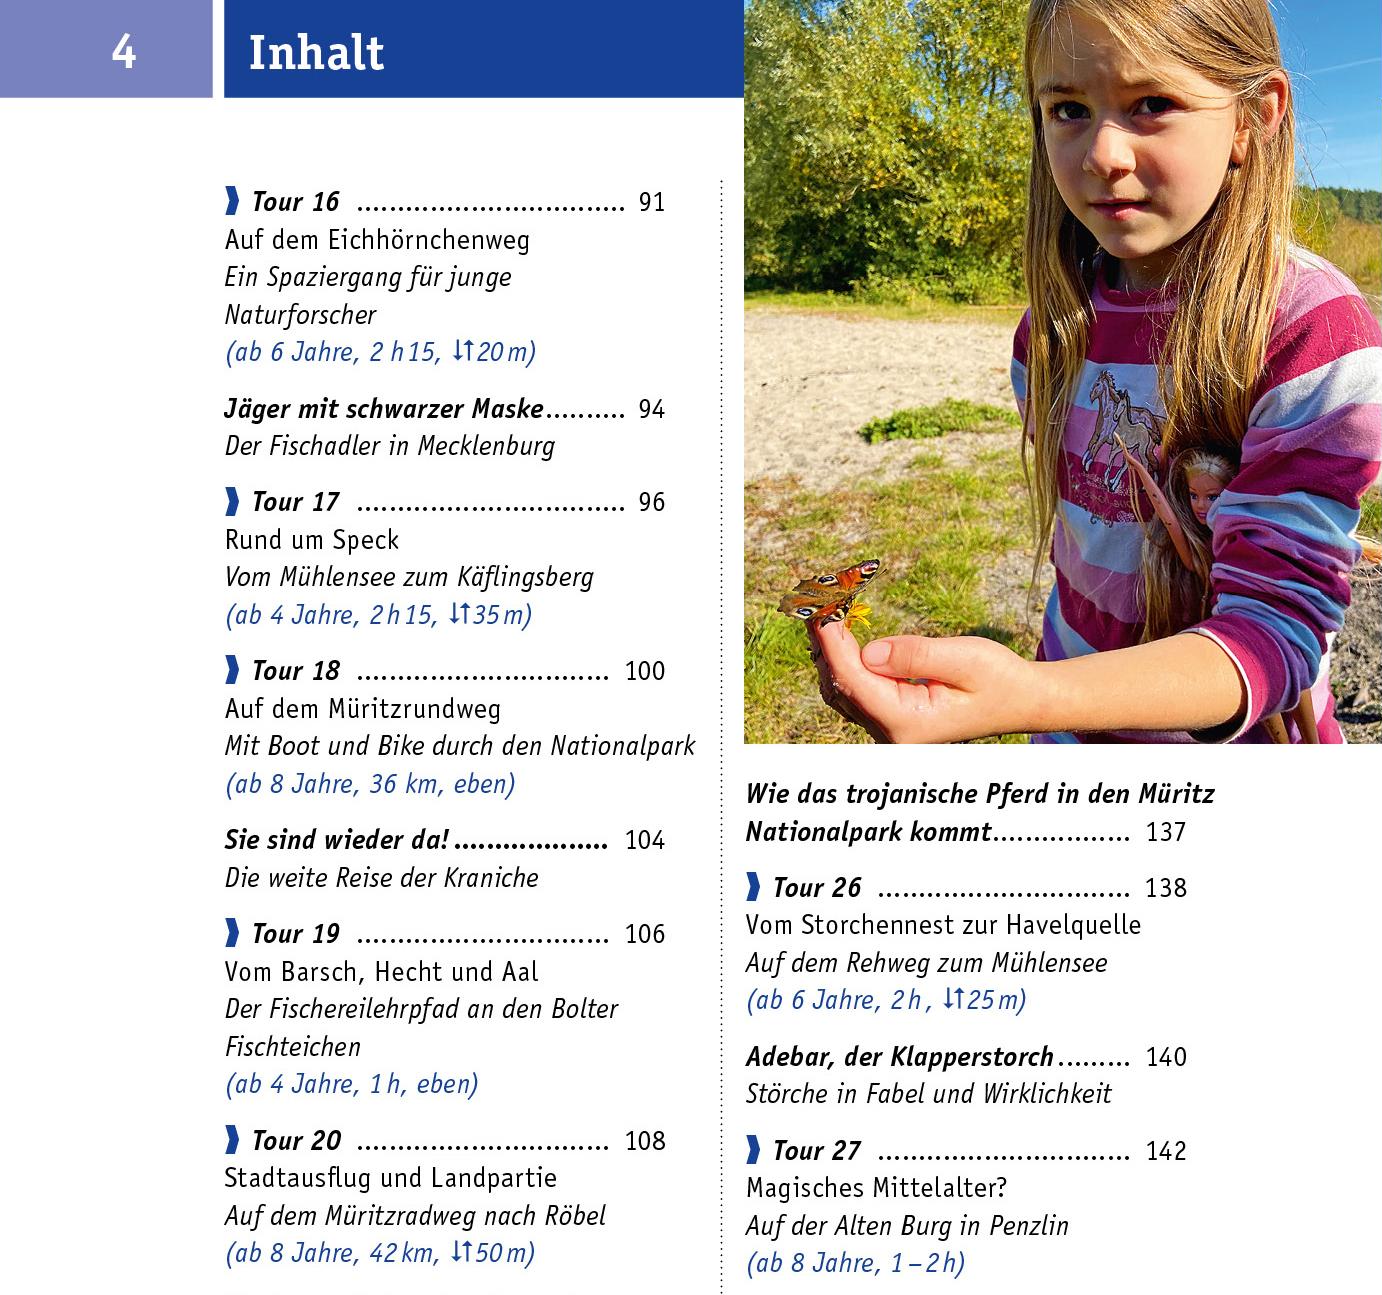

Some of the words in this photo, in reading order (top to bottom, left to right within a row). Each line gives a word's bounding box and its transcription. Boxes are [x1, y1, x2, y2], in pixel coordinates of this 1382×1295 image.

[112, 32, 137, 69] 4
[250, 32, 385, 71] Inhalt
[253, 190, 304, 212] Tour
[312, 190, 341, 212] 16
[639, 191, 665, 212] 91
[224, 227, 265, 250] Auf
[272, 227, 318, 250] dem
[329, 227, 530, 256] Eichhörnchenweg
[224, 302, 378, 331] Naturforscher
[226, 527, 282, 550] Rund
[292, 534, 323, 550] um
[333, 527, 399, 556] Speck
[224, 733, 261, 756] Mit
[267, 734, 321, 756] Boot
[328, 733, 370, 756] und
[377, 733, 425, 756] Bike
[432, 733, 493, 756] durch
[502, 733, 542, 756] den
[550, 733, 697, 762] Nationalpark
[226, 771, 262, 801] (ab
[270, 773, 284, 794] 8
[291, 771, 358, 799] Jahre,
[369, 773, 398, 794] 36
[405, 771, 445, 799] km,
[454, 771, 515, 801] eben)
[747, 781, 790, 804] Wie
[797, 781, 838, 804] das
[846, 781, 978, 811] trojanische
[985, 781, 1050, 810] Pferd
[1057, 781, 1080, 804] in
[1088, 781, 1130, 804] den
[1138, 781, 1216, 804] Müritz
[774, 876, 825, 898] Tour
[831, 876, 862, 898] 26
[1145, 877, 1187, 898] 138
[745, 913, 792, 935] Vom
[801, 912, 955, 935] Storchennest
[962, 919, 998, 935] zur
[1007, 912, 1141, 941] Havelquelle
[224, 1165, 371, 1194] Stadtausflug
[381, 1165, 422, 1188] und
[432, 1165, 557, 1194] Landpartie
[747, 1175, 864, 1204] Magisches
[873, 1175, 1007, 1198] Mittelalter?
